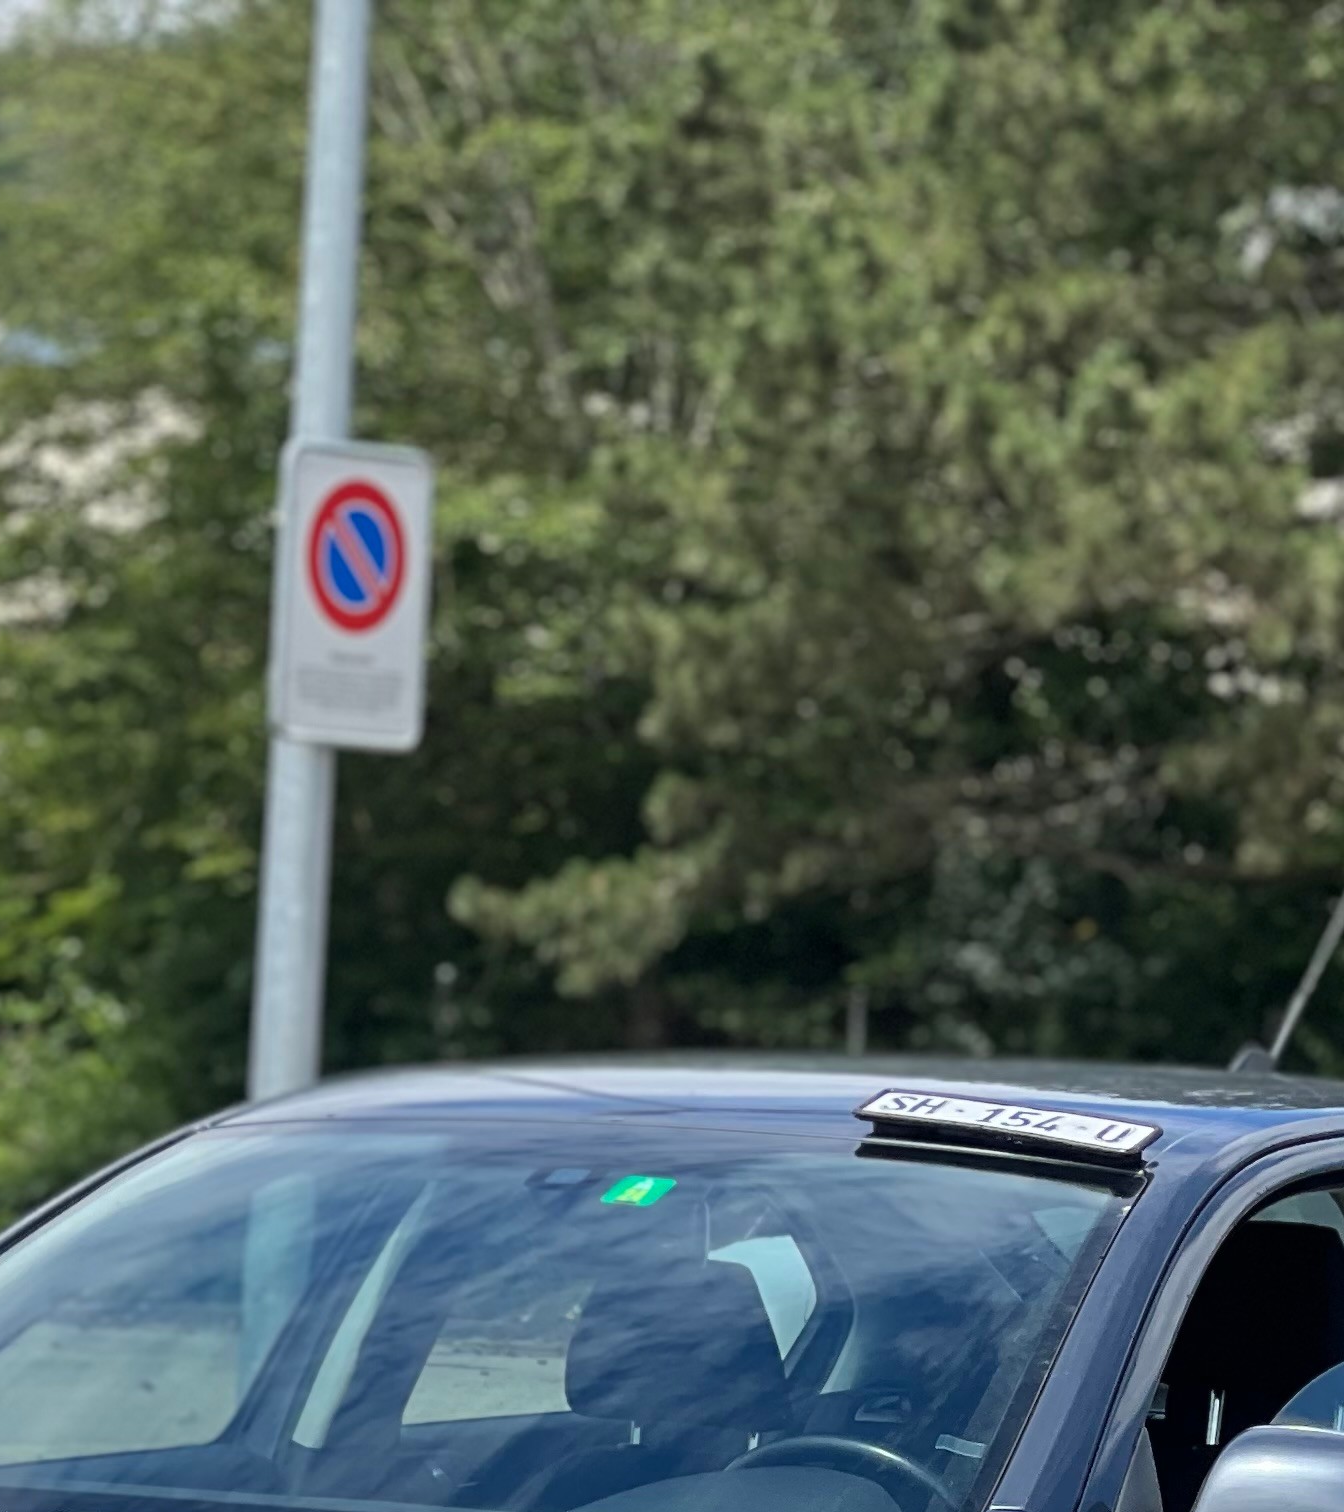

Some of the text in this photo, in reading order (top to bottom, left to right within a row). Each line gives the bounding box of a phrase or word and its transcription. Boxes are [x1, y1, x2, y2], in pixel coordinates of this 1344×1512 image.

[881, 1095, 1133, 1143] SH 154 U
